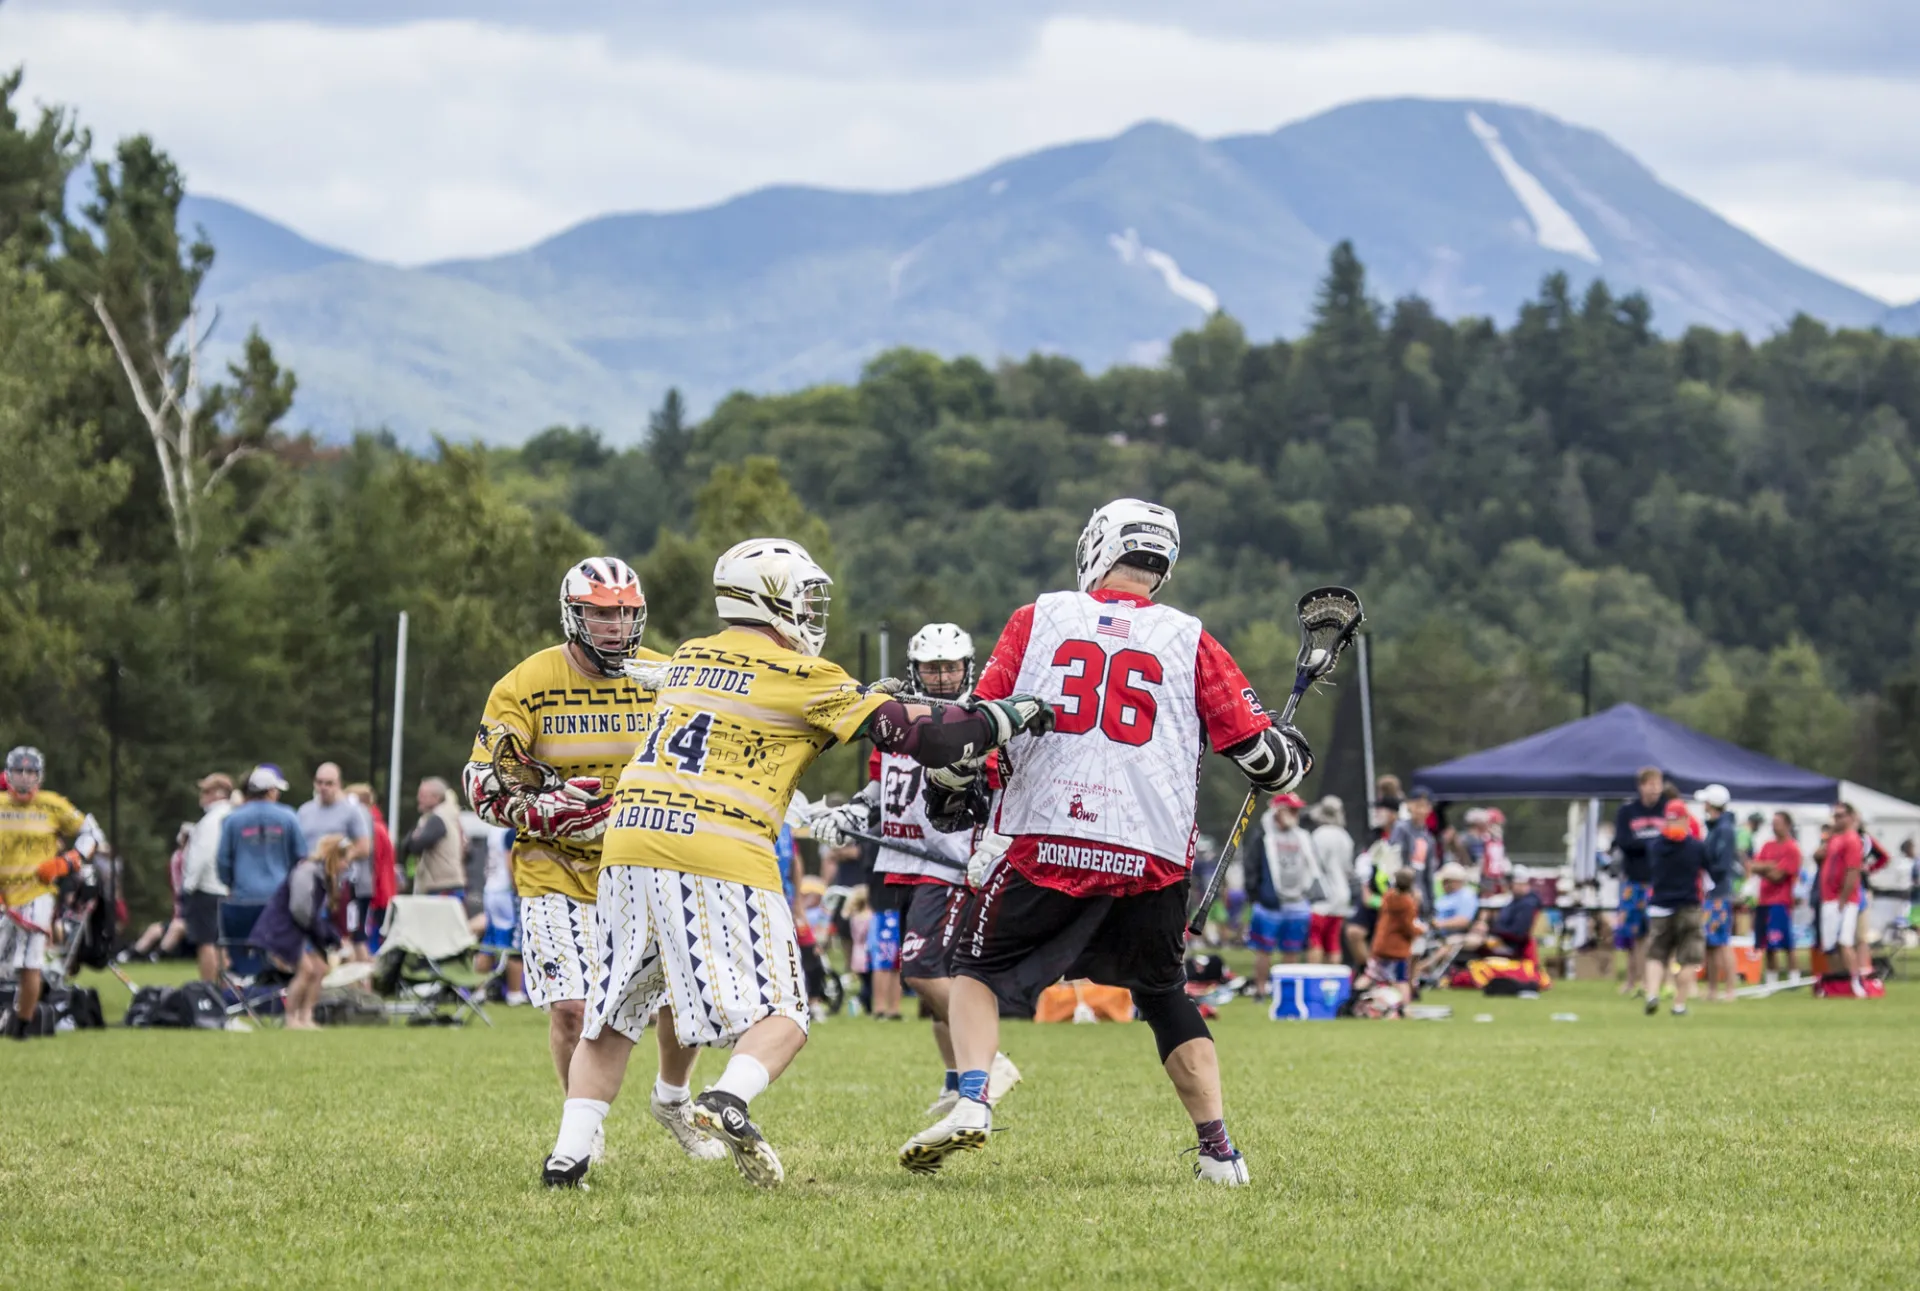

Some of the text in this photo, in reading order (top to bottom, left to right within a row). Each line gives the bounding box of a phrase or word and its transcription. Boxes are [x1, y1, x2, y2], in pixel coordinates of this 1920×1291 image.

[694, 667, 755, 696] DUDE
[1051, 639, 1163, 748] 36
[542, 713, 621, 735] RUNNING
[637, 708, 715, 776] 14
[885, 771, 913, 807] 27
[1053, 778, 1124, 796] FEDERAL PRISON
[613, 805, 698, 836] ABIDES
[1076, 810, 1099, 824] OWU
[1037, 841, 1147, 878] HORNBERGER
